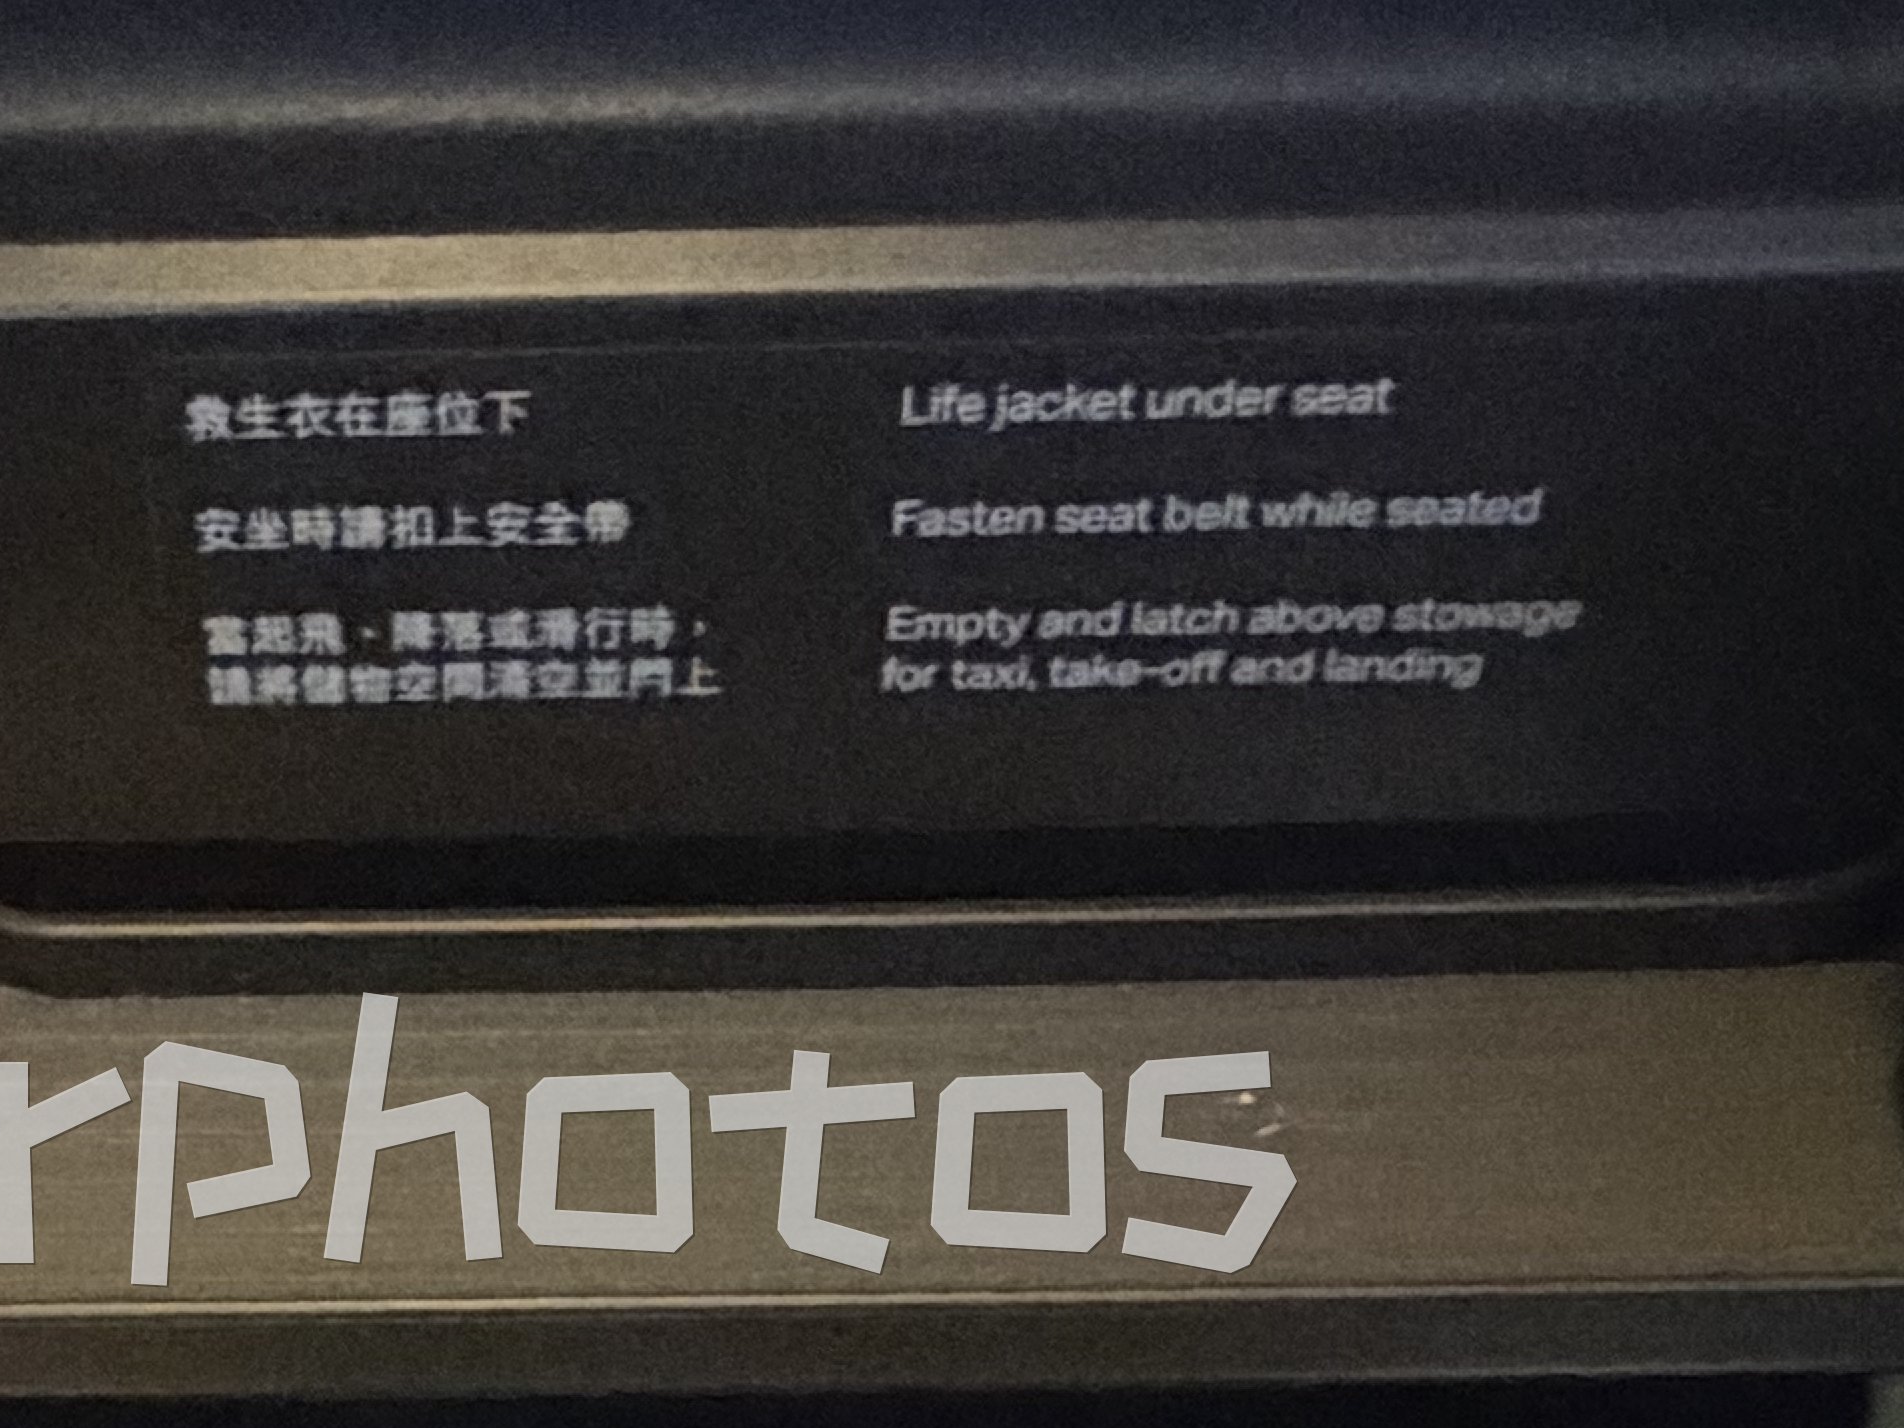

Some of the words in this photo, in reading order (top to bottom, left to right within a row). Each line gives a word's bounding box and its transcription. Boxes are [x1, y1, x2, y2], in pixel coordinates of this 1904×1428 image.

[186, 390, 532, 441] 救生衣在座位下
[899, 384, 986, 427] Life
[989, 383, 1136, 432] jacket
[1146, 378, 1284, 420] under
[1292, 377, 1396, 416] seat
[195, 500, 631, 553] 安坐時請扣上安全帶
[892, 498, 1045, 538] Fasten
[1054, 498, 1152, 535] seat
[1162, 494, 1251, 532] belt
[1260, 491, 1378, 529] while
[1386, 487, 1544, 526] seated
[885, 605, 1032, 648] Empty
[1038, 600, 1124, 640] and
[1129, 599, 1240, 636] latch
[1247, 600, 1385, 634] above
[1393, 598, 1582, 638] stowage
[880, 655, 939, 692] for
[950, 655, 1037, 691] taxi,
[1048, 649, 1228, 689] take-off
[1229, 650, 1316, 685] and
[1323, 648, 1484, 690] landing
